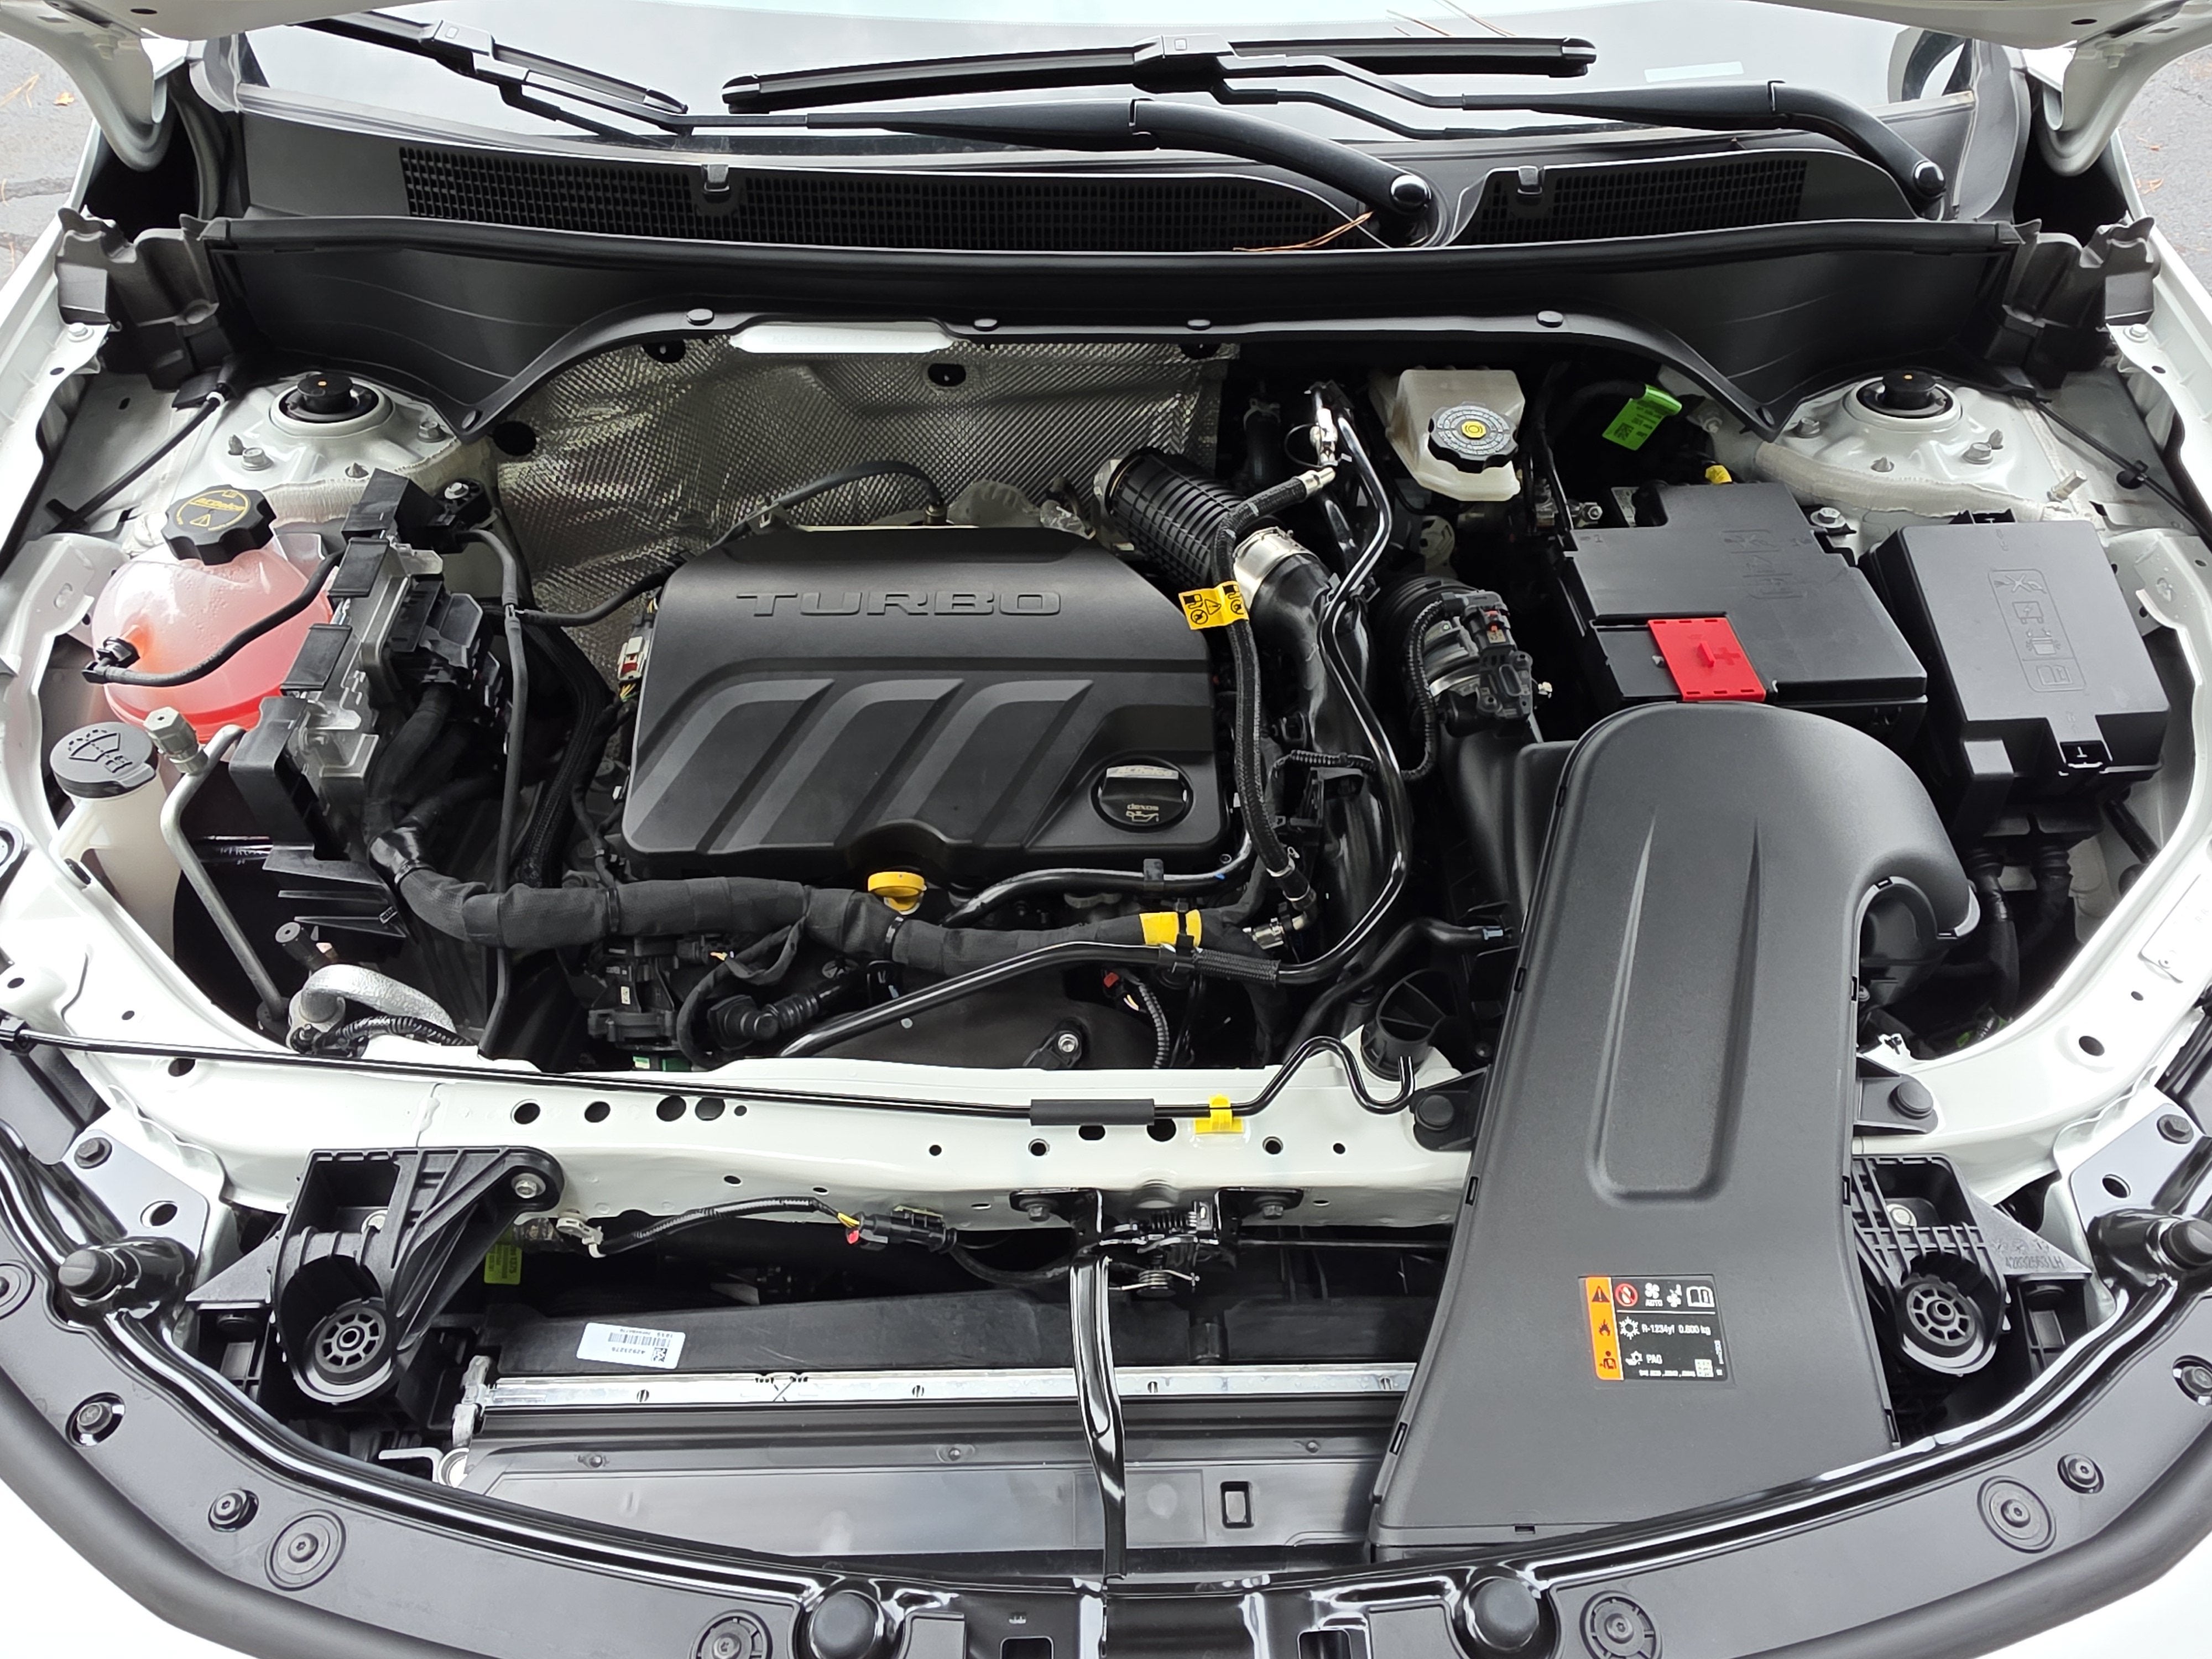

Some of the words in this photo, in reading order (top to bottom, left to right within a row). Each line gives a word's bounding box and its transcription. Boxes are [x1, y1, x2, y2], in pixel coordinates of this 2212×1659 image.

[736, 591, 1061, 617] TURBO
[1641, 1324, 1675, 1335] R-1234yf
[1700, 1325, 1712, 1335] kg
[1646, 1354, 1663, 1365] PAG
